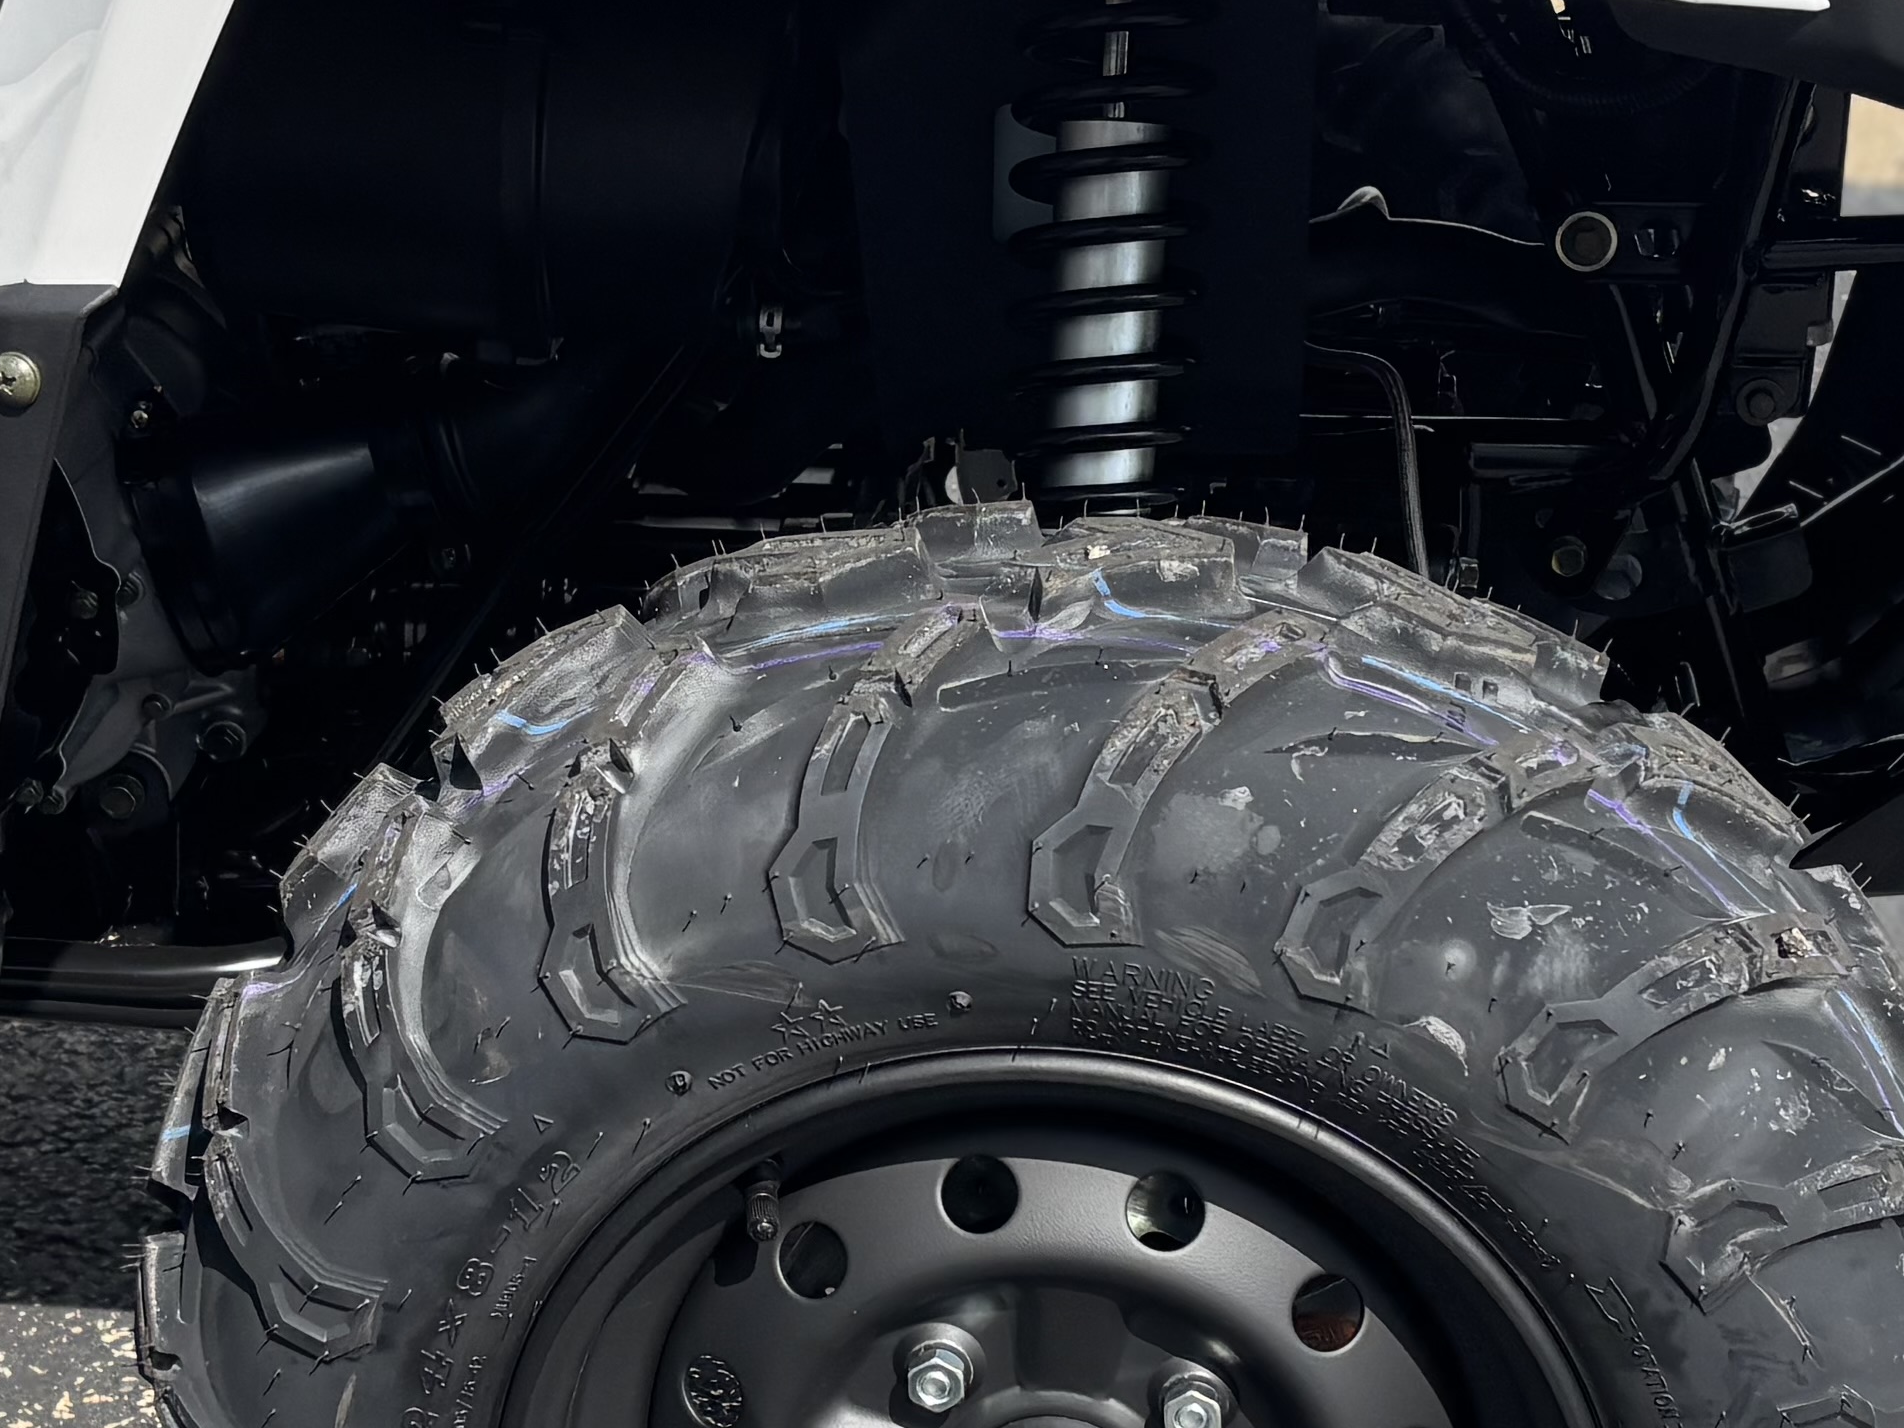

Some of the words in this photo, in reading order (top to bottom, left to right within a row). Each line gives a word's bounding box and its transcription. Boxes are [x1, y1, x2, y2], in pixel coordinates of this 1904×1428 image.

[1072, 956, 1215, 1000] WARNING
[1072, 979, 1117, 1001] SEE
[707, 1062, 746, 1091] NOT
[751, 1046, 794, 1072] FOR
[796, 1019, 888, 1056] HIGHWAY
[897, 1012, 938, 1031] USE
[1629, 1331, 1681, 1420] ROTATION
